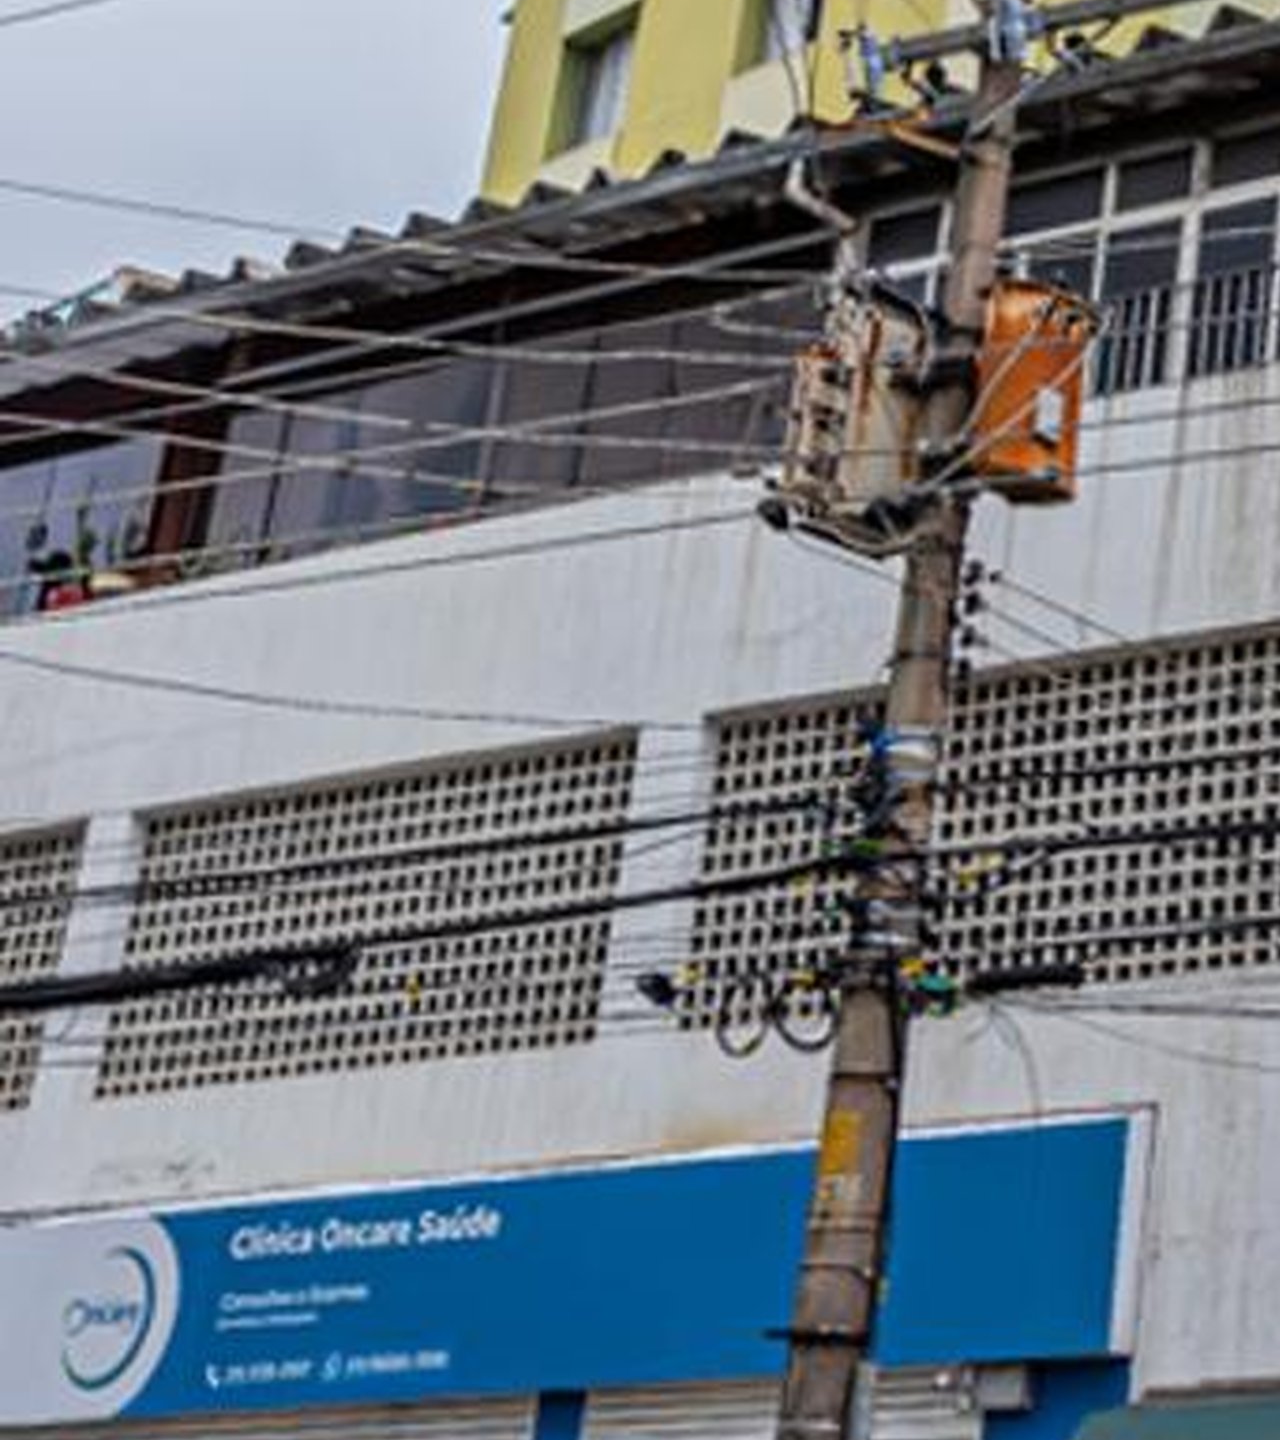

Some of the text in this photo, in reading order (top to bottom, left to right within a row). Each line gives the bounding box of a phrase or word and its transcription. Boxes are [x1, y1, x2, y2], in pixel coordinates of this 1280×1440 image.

[229, 1203, 502, 1260] Clínica Oncare Saúde
